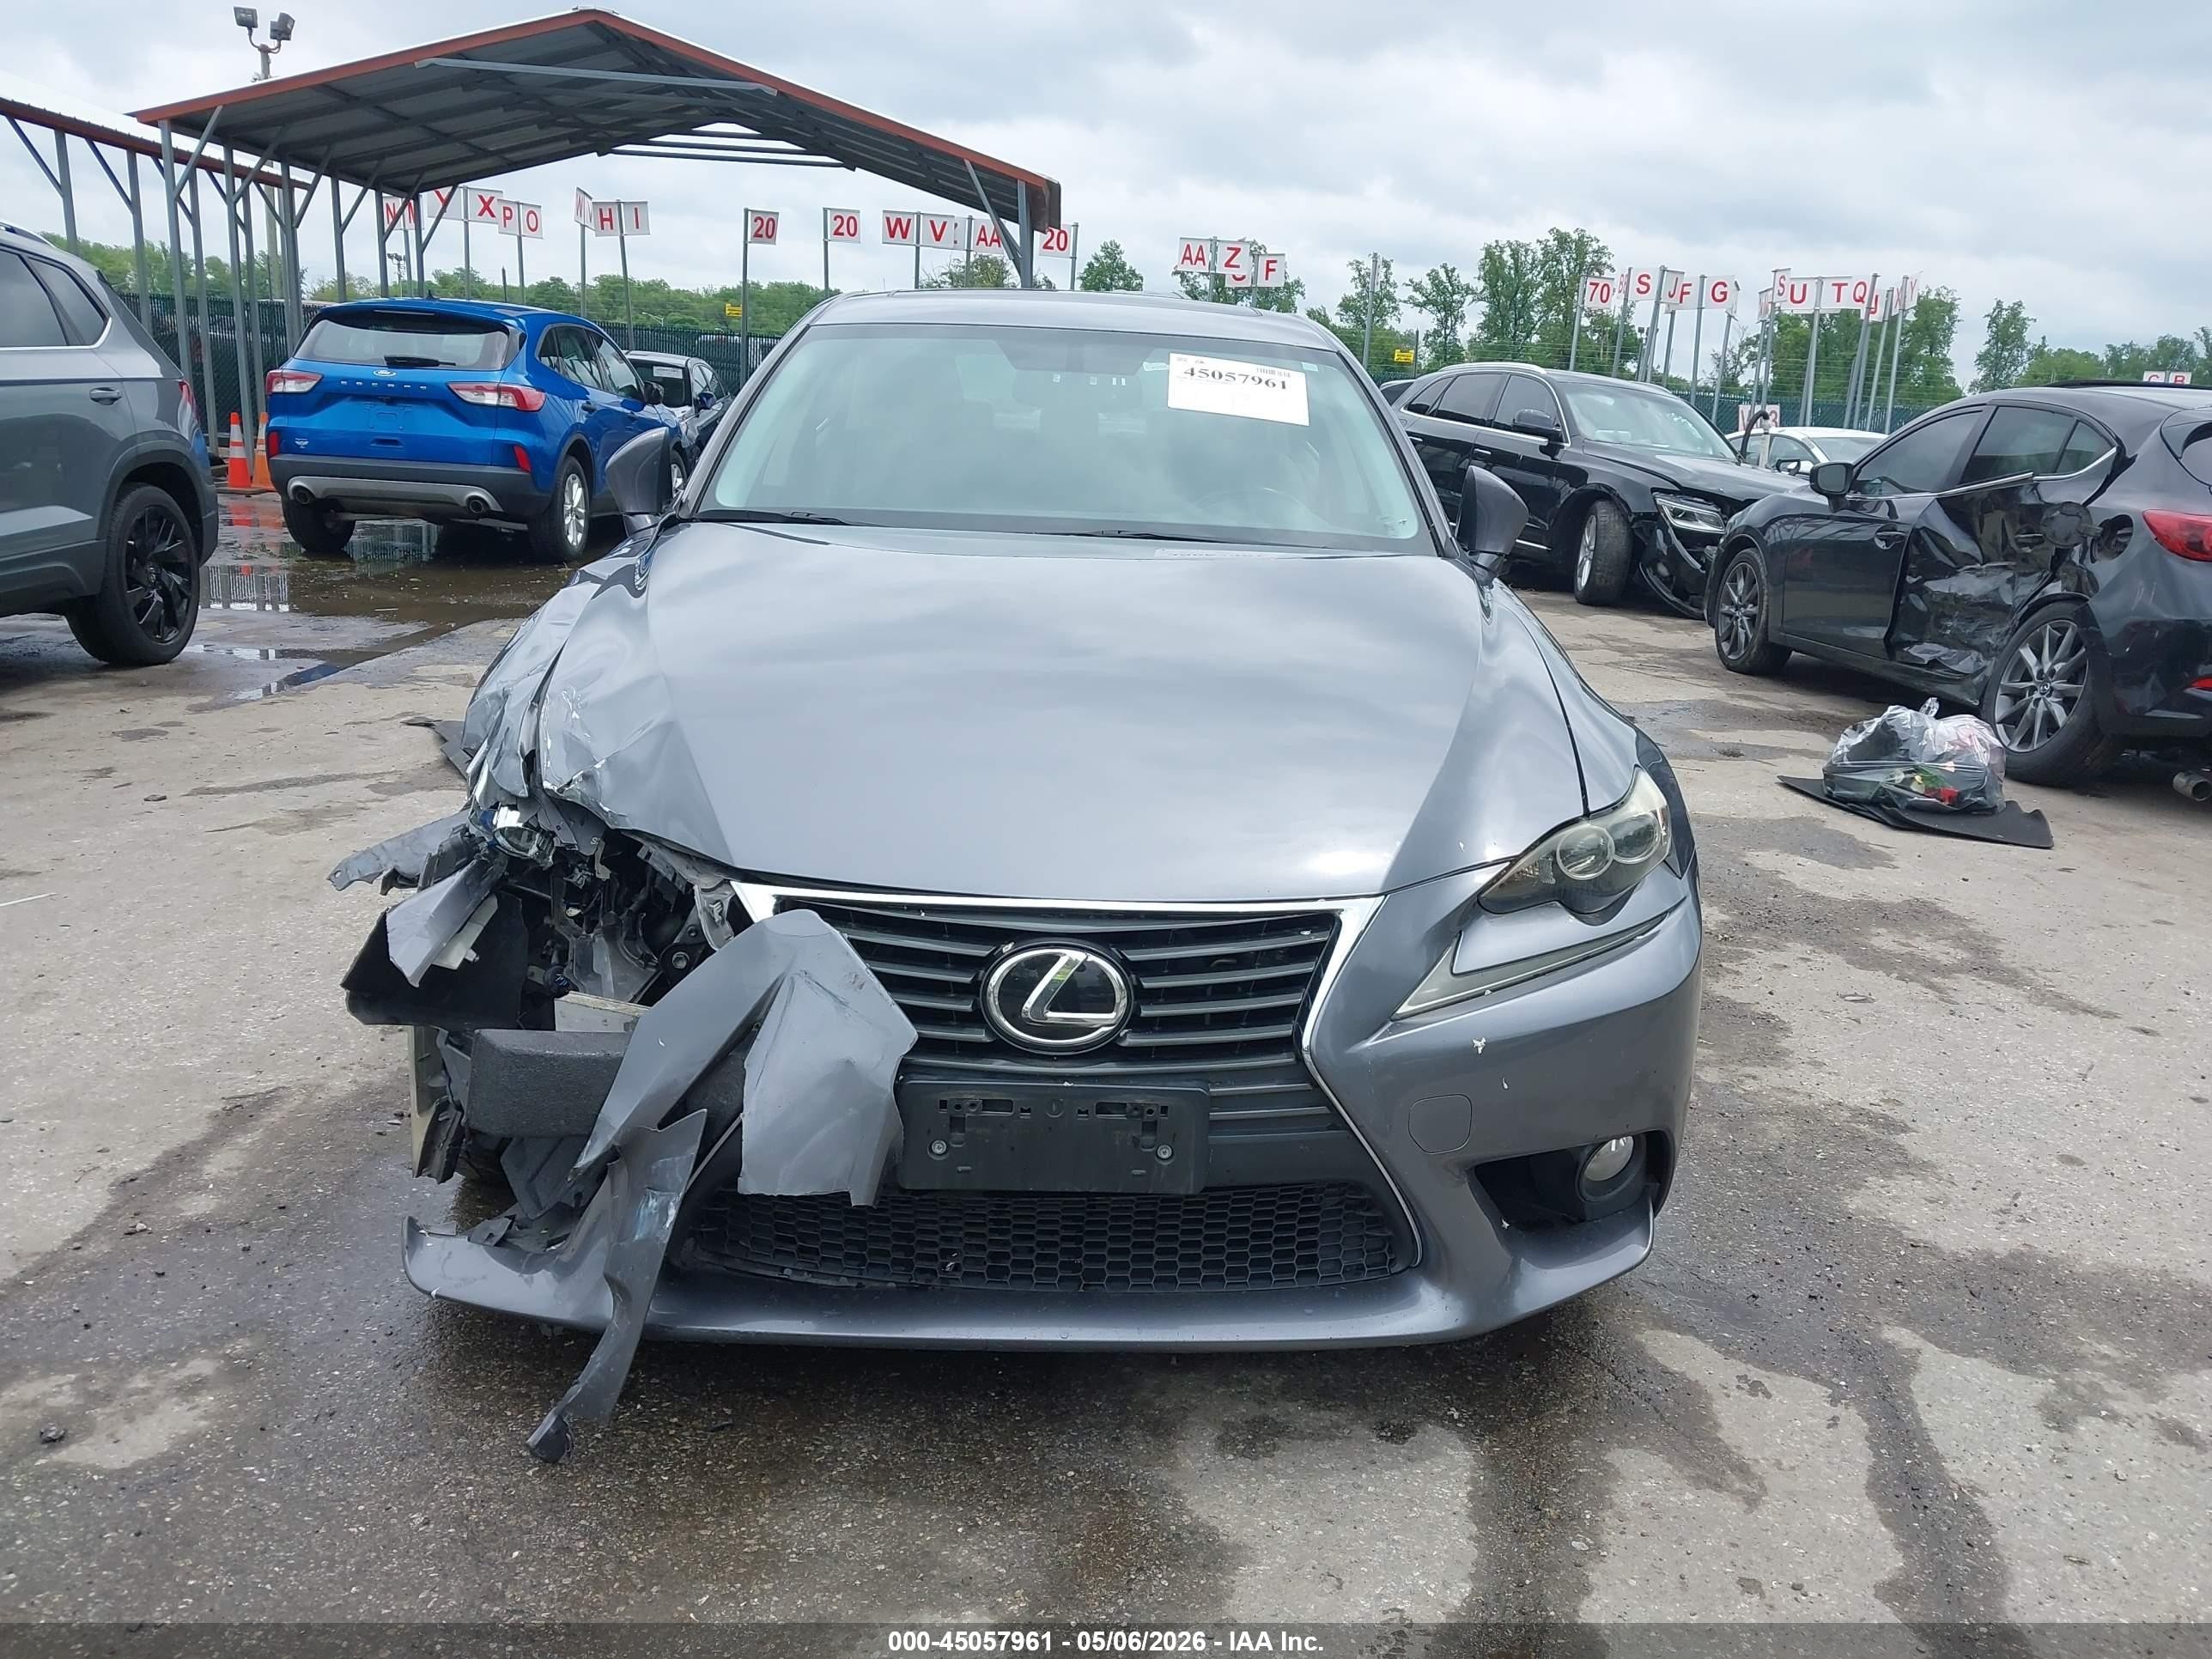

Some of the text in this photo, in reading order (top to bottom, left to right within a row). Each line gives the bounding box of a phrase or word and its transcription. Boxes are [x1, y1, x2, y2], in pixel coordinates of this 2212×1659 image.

[477, 194, 496, 218] X
[502, 205, 538, 233] P O
[599, 207, 640, 231] H I
[753, 216, 775, 240] 20
[832, 214, 858, 237] 20
[885, 216, 912, 240] W
[929, 219, 948, 242] V
[975, 224, 1002, 248] AA
[1042, 228, 1068, 252] 20
[1181, 243, 1242, 269] AA Z
[1264, 259, 1278, 282] F
[1589, 281, 1611, 304] 70
[1636, 273, 1651, 295] S
[1668, 276, 1679, 299] J
[1679, 281, 1729, 304] F G
[1777, 274, 1786, 297] S
[1790, 283, 1808, 304] U
[1831, 282, 1849, 303] T
[1852, 281, 1867, 304] Q
[1910, 278, 1917, 302] Y
[1183, 366, 1287, 390] 45057961
